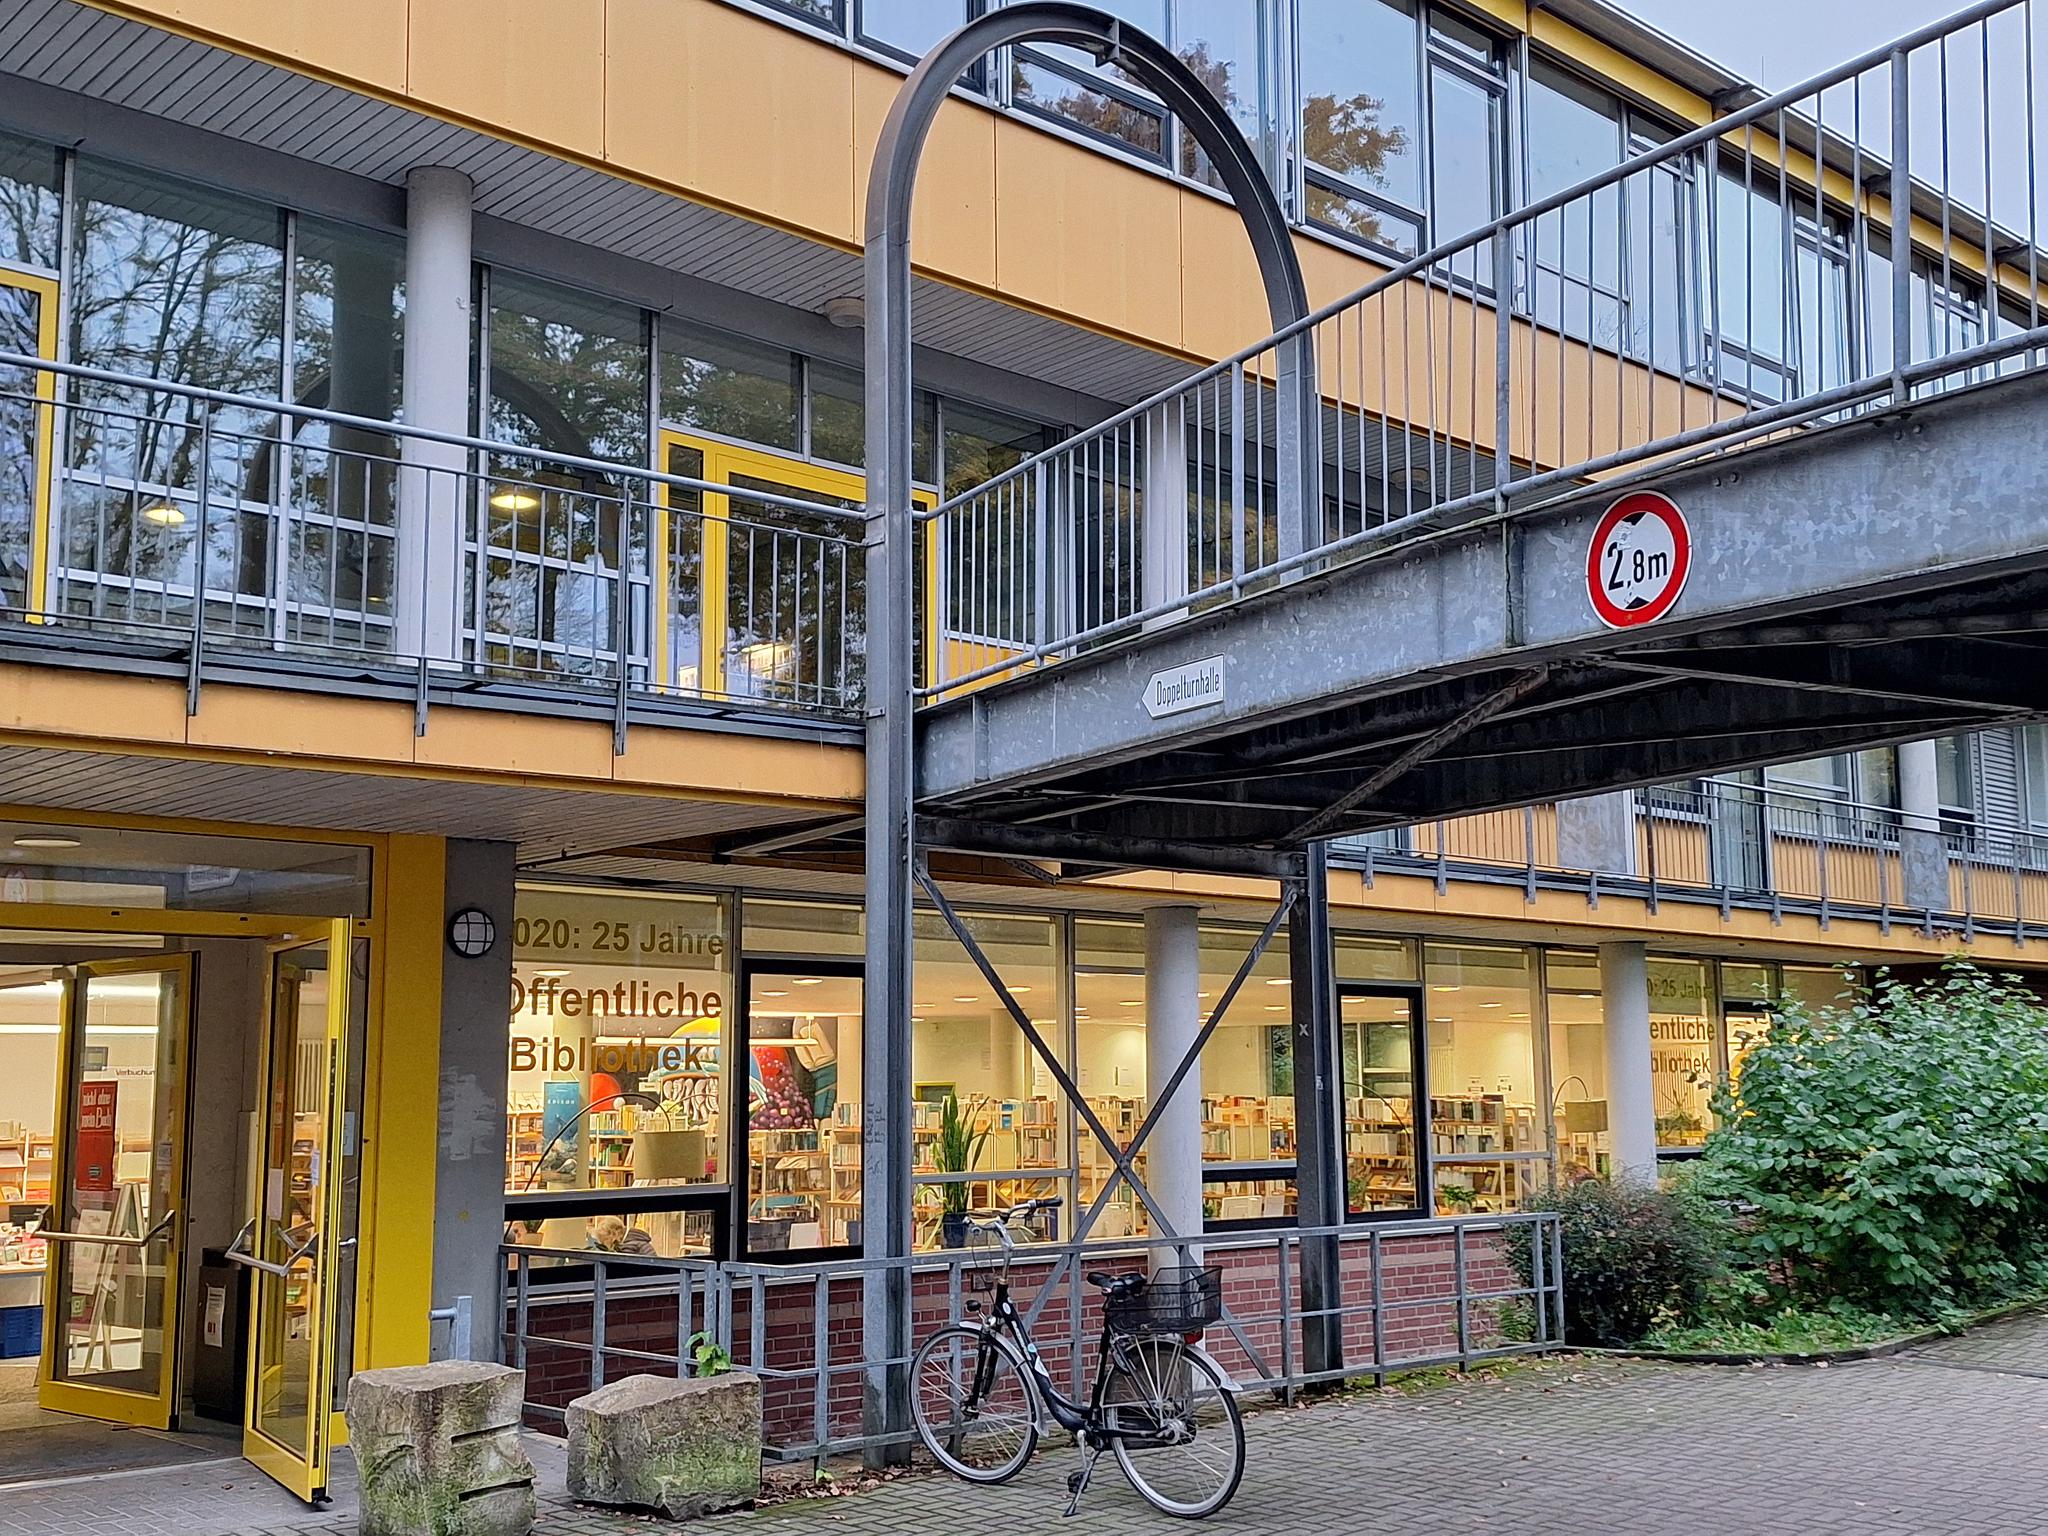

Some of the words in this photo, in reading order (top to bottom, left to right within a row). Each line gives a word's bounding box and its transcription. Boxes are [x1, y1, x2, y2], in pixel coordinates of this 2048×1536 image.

[1607, 541, 1668, 591] 2,8m
[1156, 666, 1220, 707] Doppelturnhalle
[514, 917, 580, 949] 020:
[592, 921, 629, 952] 25
[640, 924, 723, 955] Jahre
[1661, 979, 1677, 997] 25
[1650, 1016, 1715, 1040] entliche
[511, 1036, 703, 1072] Bibliothek
